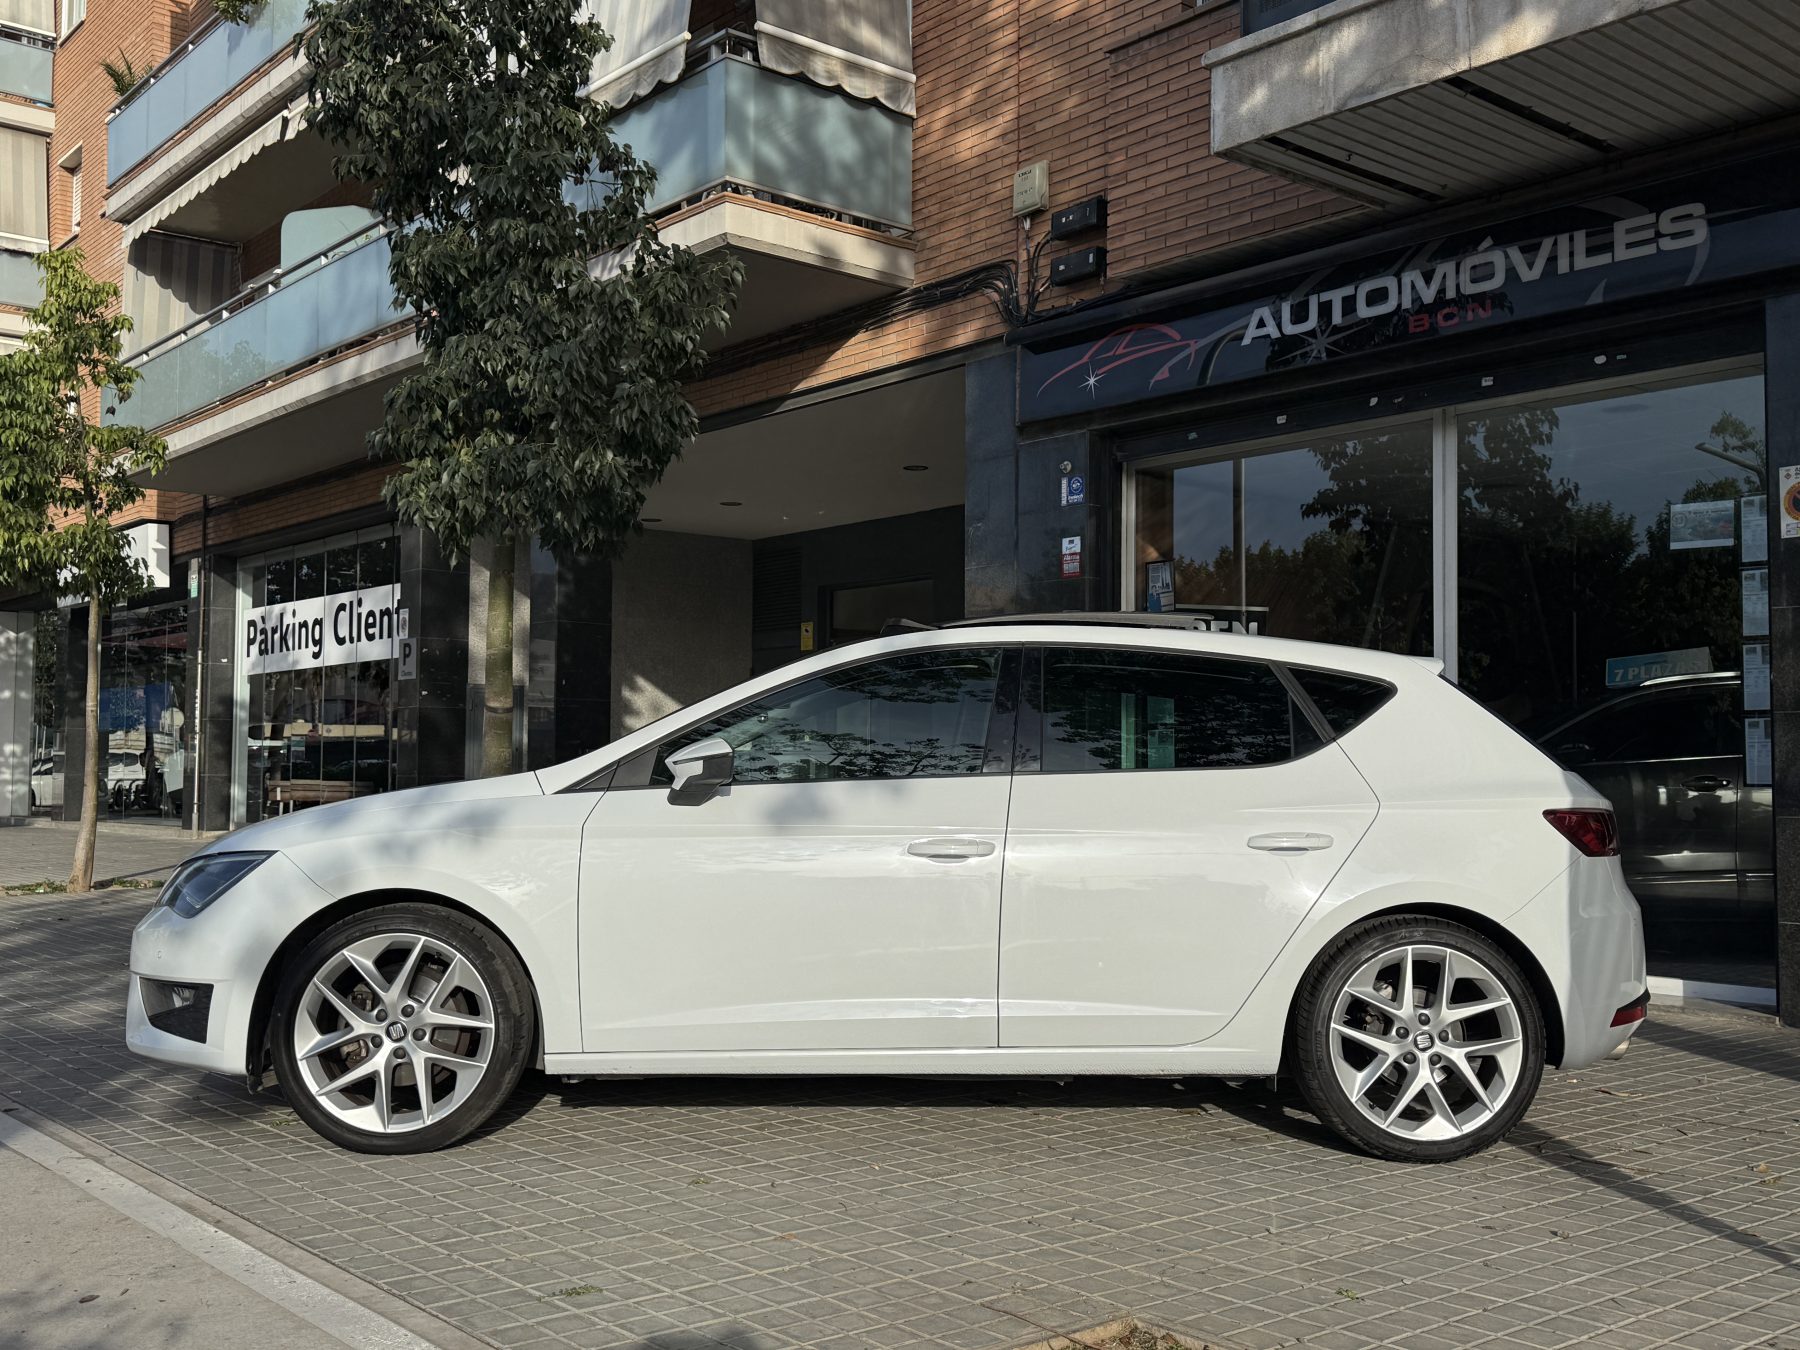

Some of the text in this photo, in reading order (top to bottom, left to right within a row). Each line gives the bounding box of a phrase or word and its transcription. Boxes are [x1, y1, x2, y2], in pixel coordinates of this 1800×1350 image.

[1240, 202, 1707, 346] AUTOMÓVILES
[1407, 301, 1493, 334] BCN
[246, 609, 323, 660] Pàrking
[403, 643, 412, 666] P
[1614, 669, 1625, 682] 7
